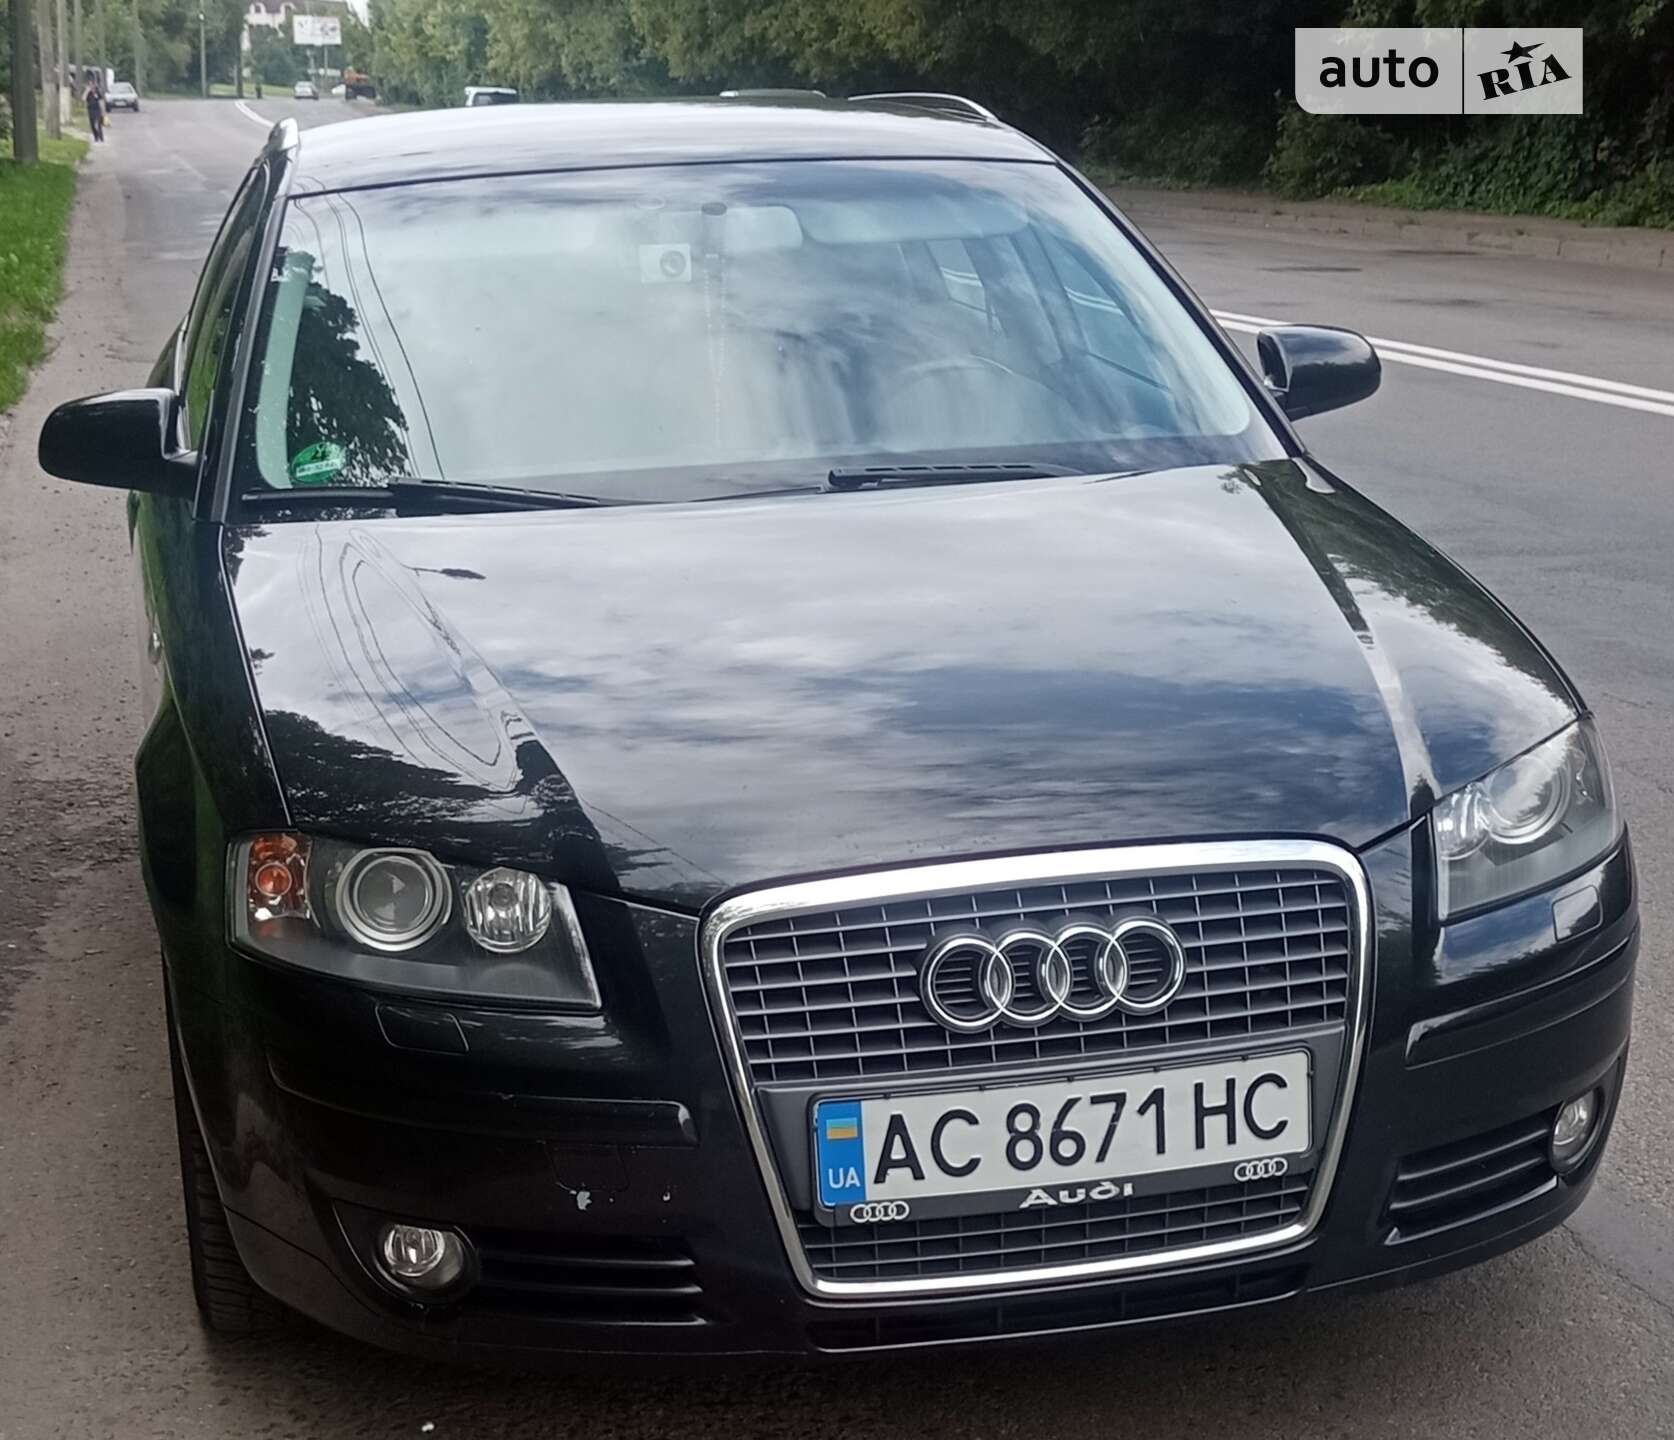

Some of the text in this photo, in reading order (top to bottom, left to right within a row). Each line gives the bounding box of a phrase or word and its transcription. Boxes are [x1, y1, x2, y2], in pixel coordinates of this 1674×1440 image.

[873, 1072, 1289, 1185] AC 8671 HC
[828, 1167, 861, 1190] UA
[1019, 1181, 1133, 1209] Audi
